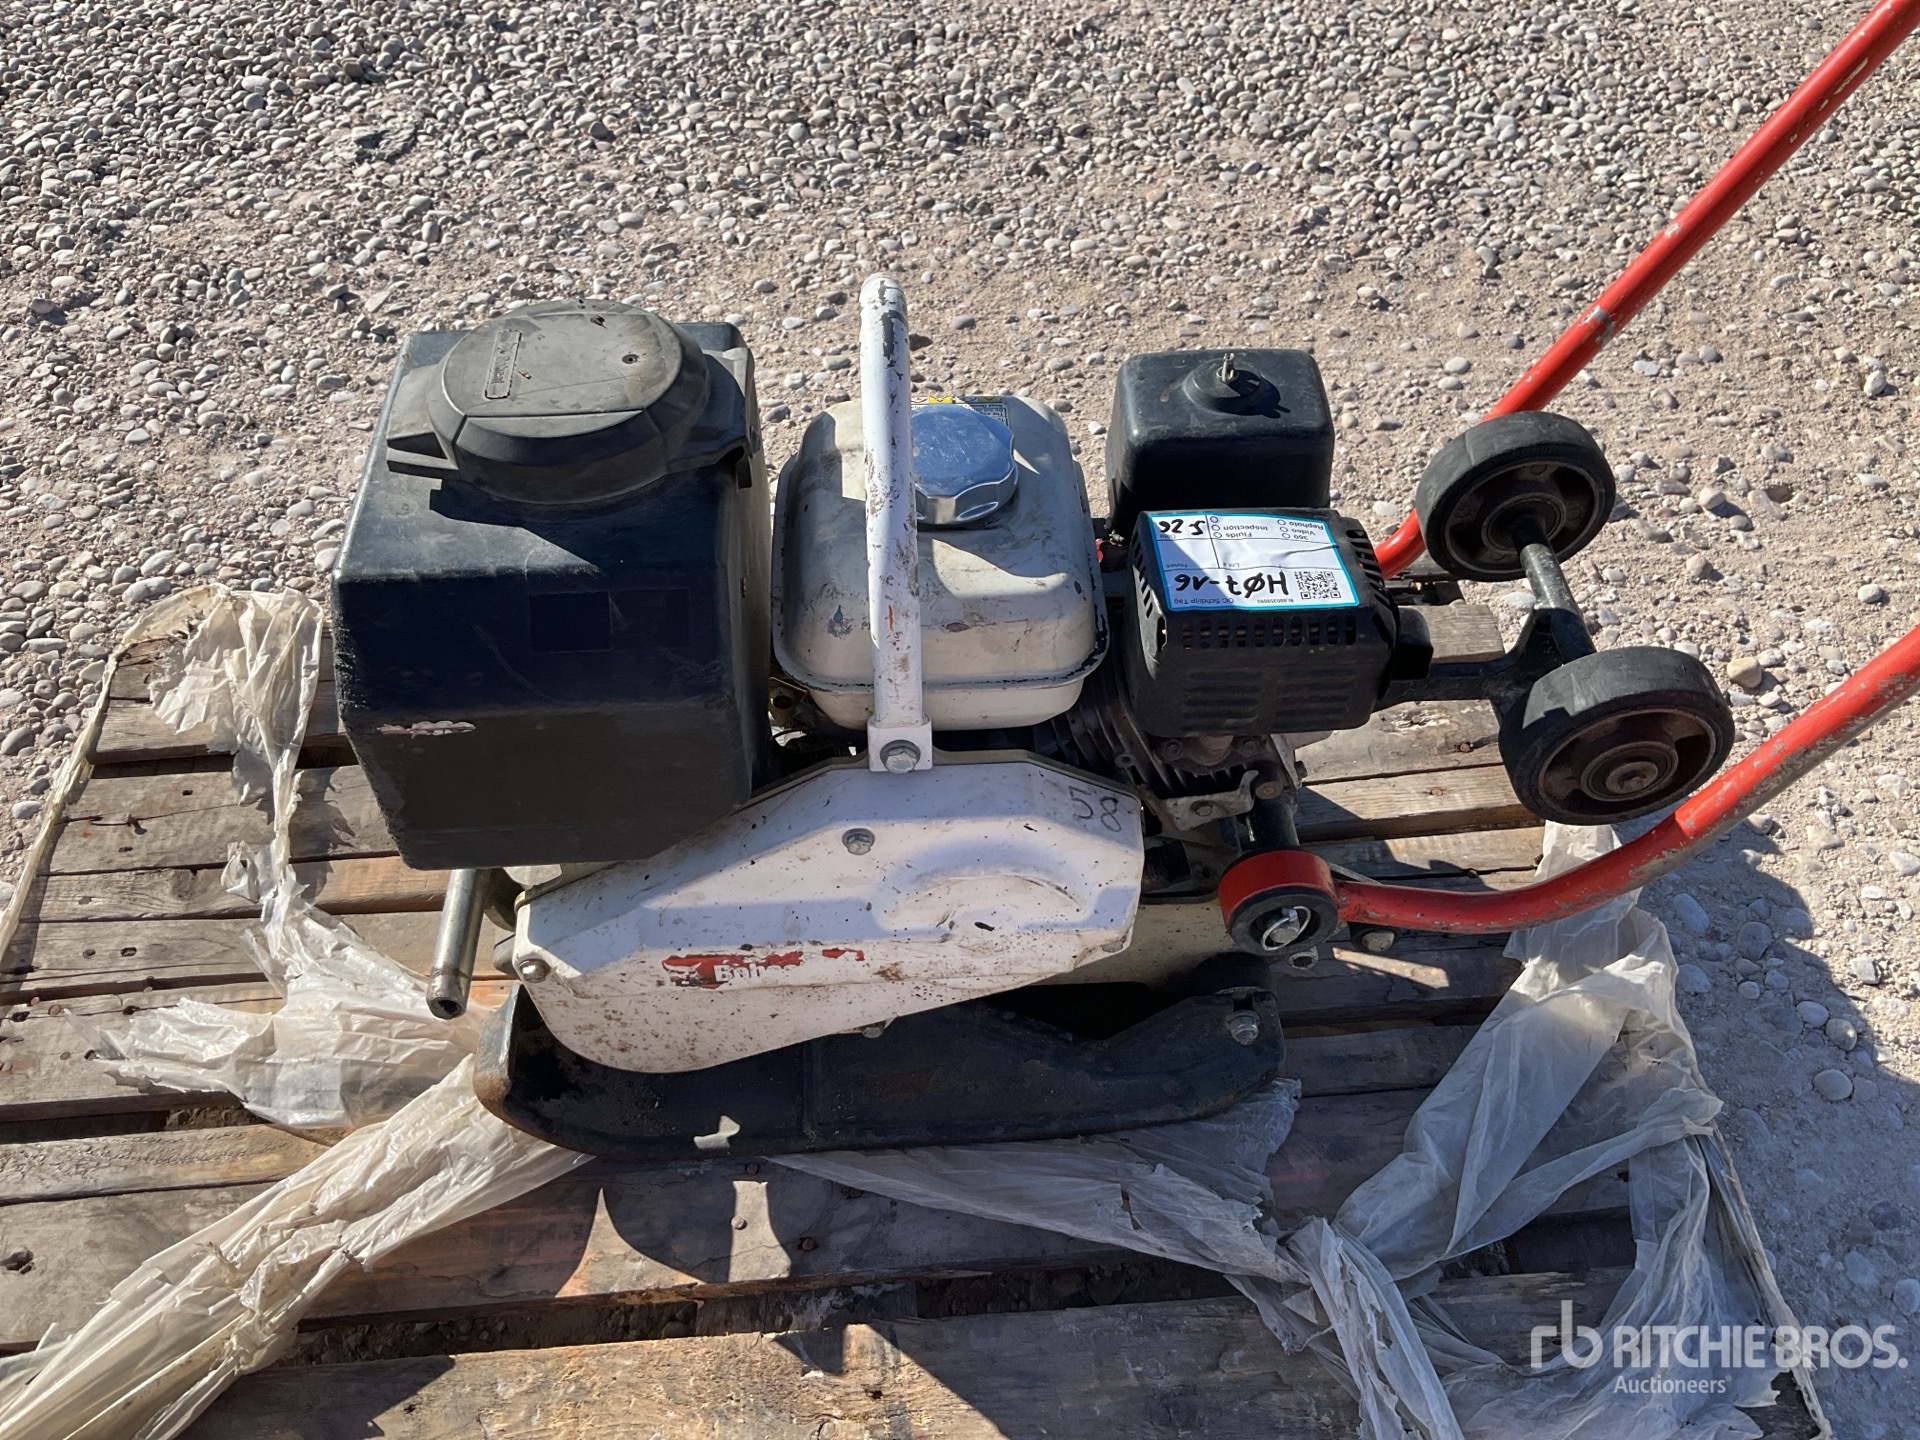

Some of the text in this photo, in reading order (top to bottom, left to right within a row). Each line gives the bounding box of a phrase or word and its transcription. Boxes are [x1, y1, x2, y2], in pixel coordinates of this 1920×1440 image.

[1289, 521, 1324, 531] Rephoto
[1291, 528, 1316, 536] Video
[1068, 786, 1122, 832] 58
